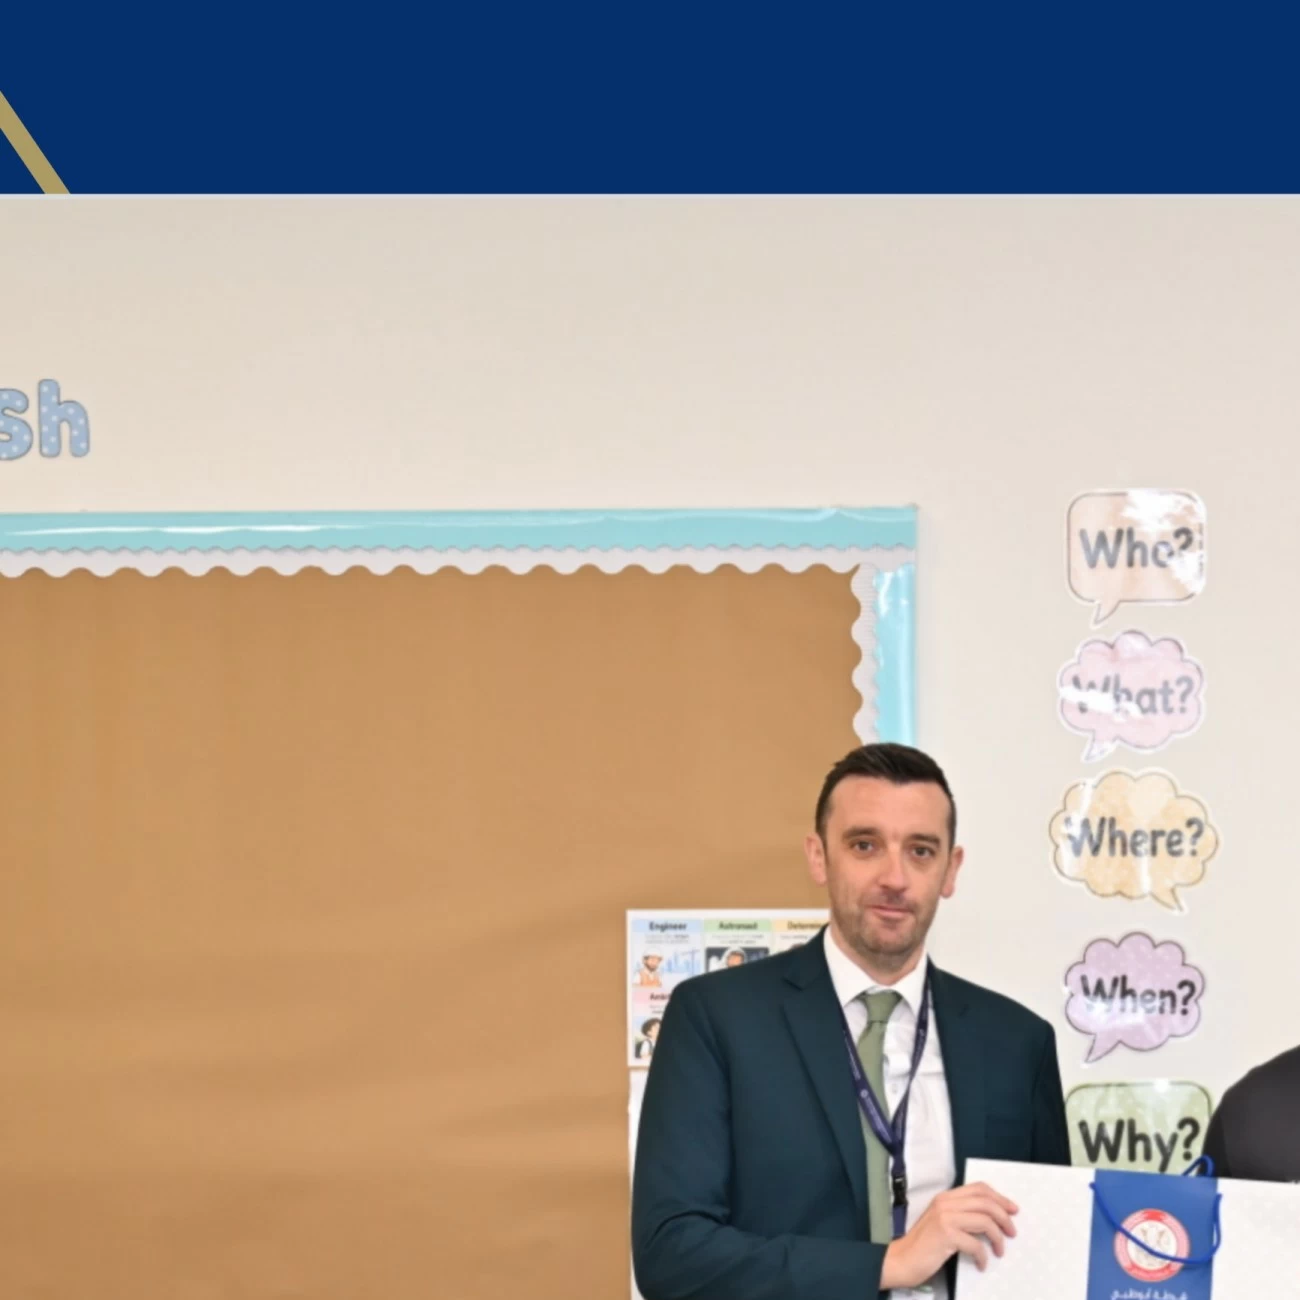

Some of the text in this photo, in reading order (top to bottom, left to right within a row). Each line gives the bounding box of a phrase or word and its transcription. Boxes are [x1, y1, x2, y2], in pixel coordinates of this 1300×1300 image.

[1078, 526, 1194, 569] Who?
[1065, 816, 1202, 858] Where?
[649, 922, 687, 932] Engineer
[1080, 974, 1196, 1016] When?
[1078, 1117, 1200, 1174] Why?
